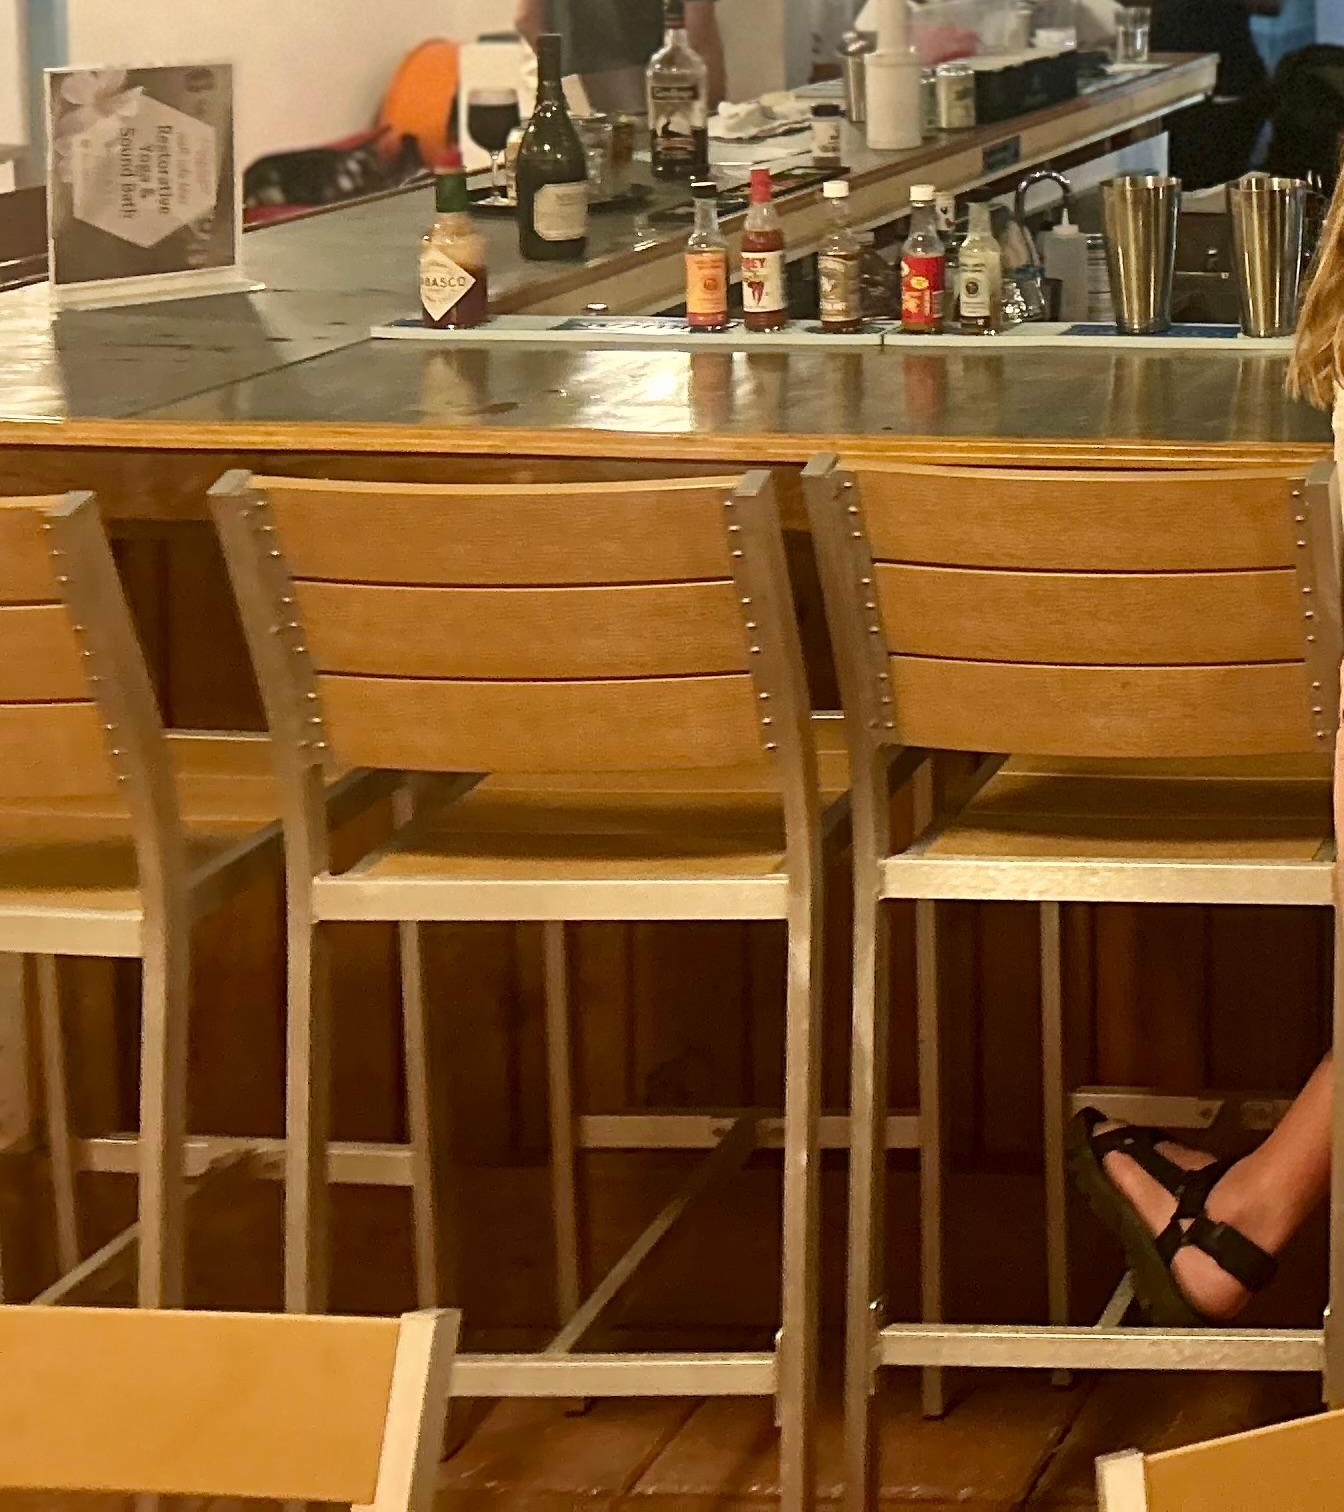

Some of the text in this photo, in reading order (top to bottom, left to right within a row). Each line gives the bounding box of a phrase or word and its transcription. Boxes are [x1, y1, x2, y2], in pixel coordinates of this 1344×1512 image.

[120, 128, 137, 219] Sound Bath
[137, 145, 153, 182] Yoga
[157, 125, 174, 214] Restorative
[421, 276, 466, 289] BASCO
